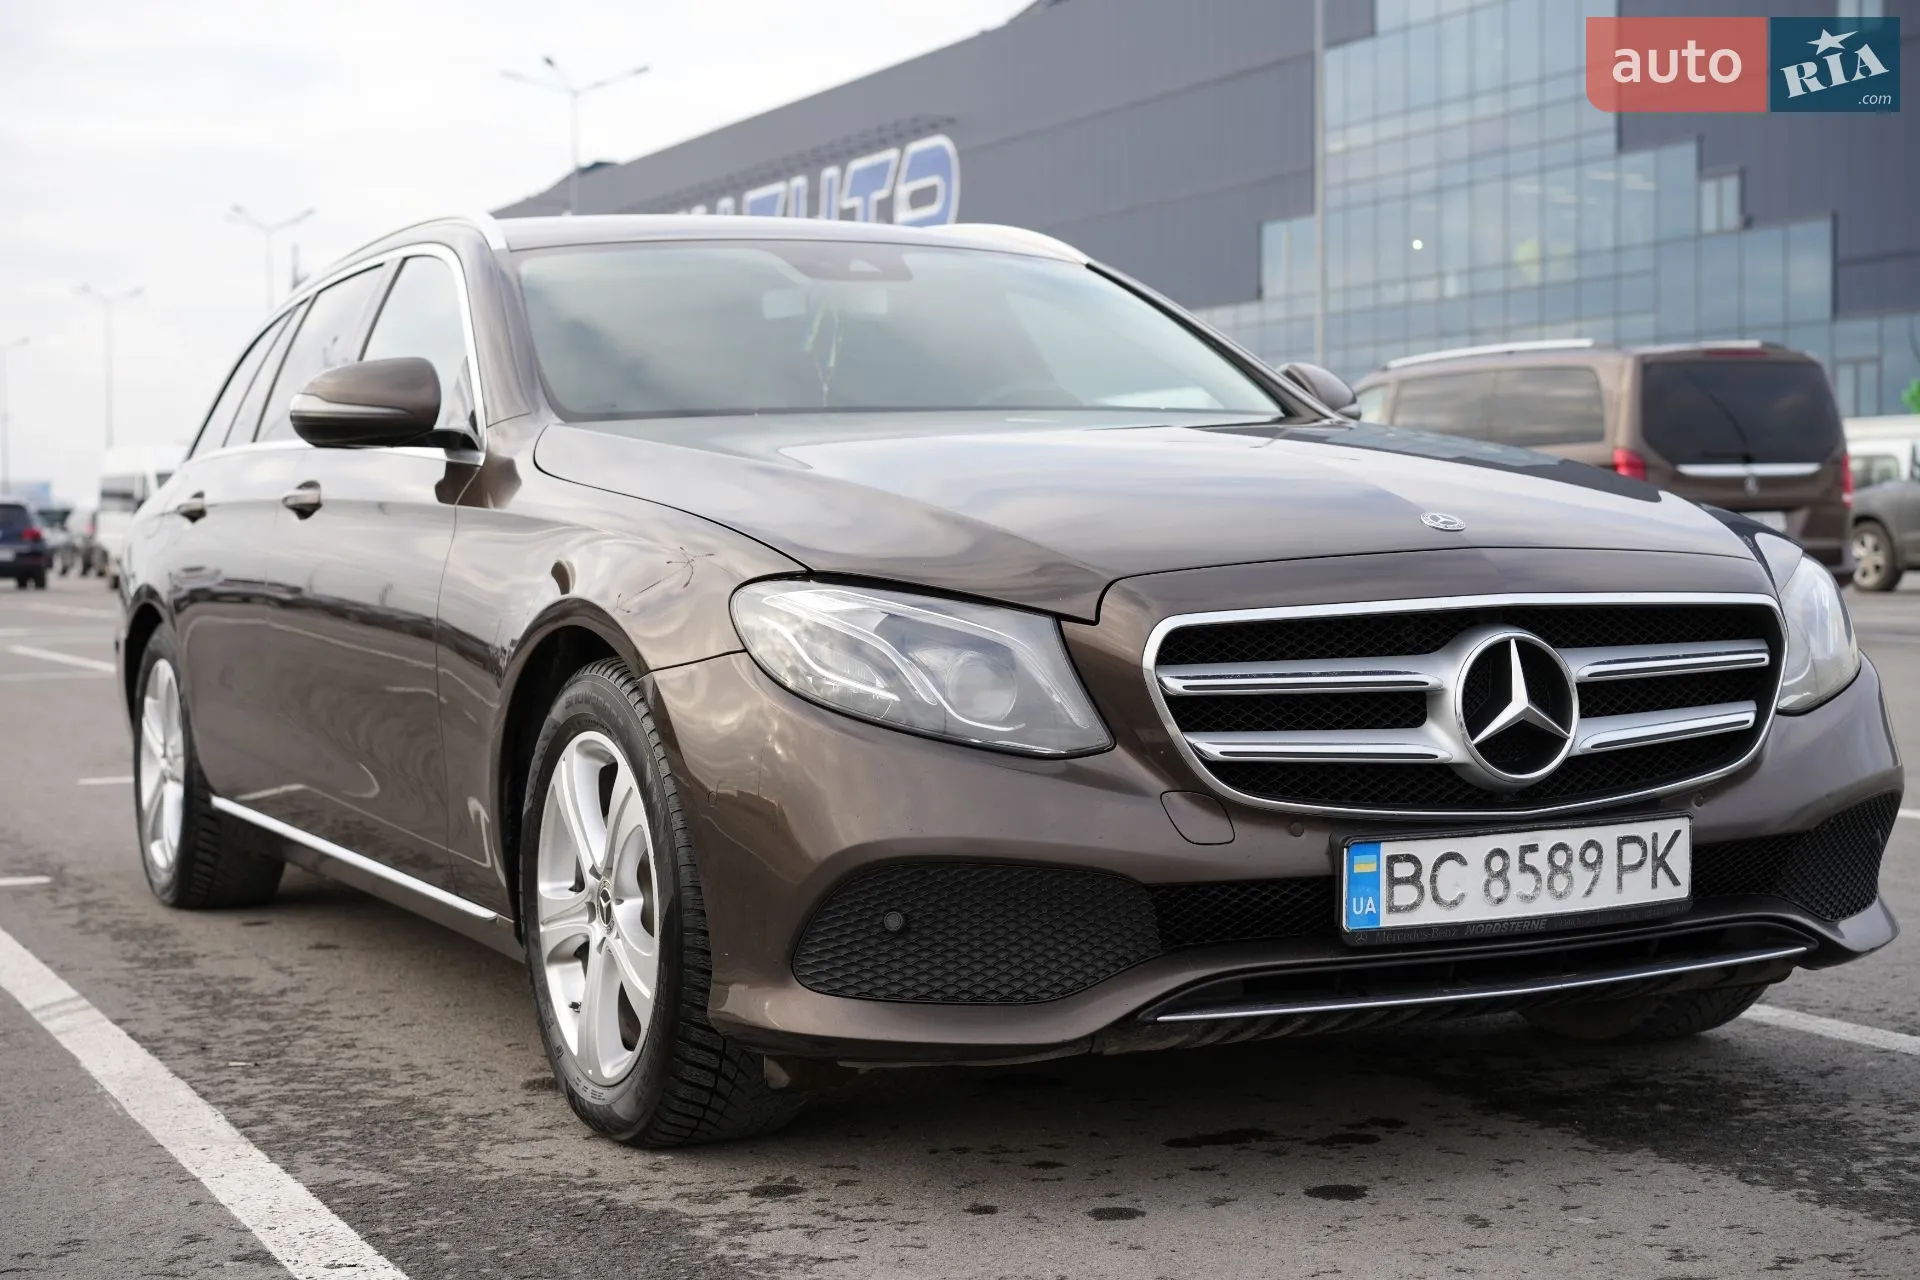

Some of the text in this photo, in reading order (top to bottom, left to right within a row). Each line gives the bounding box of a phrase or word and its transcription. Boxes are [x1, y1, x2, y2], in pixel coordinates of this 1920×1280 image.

[1385, 829, 1682, 915] BC 8589 PK
[1352, 896, 1377, 915] UA
[1464, 918, 1549, 936] NORDSTERNE
